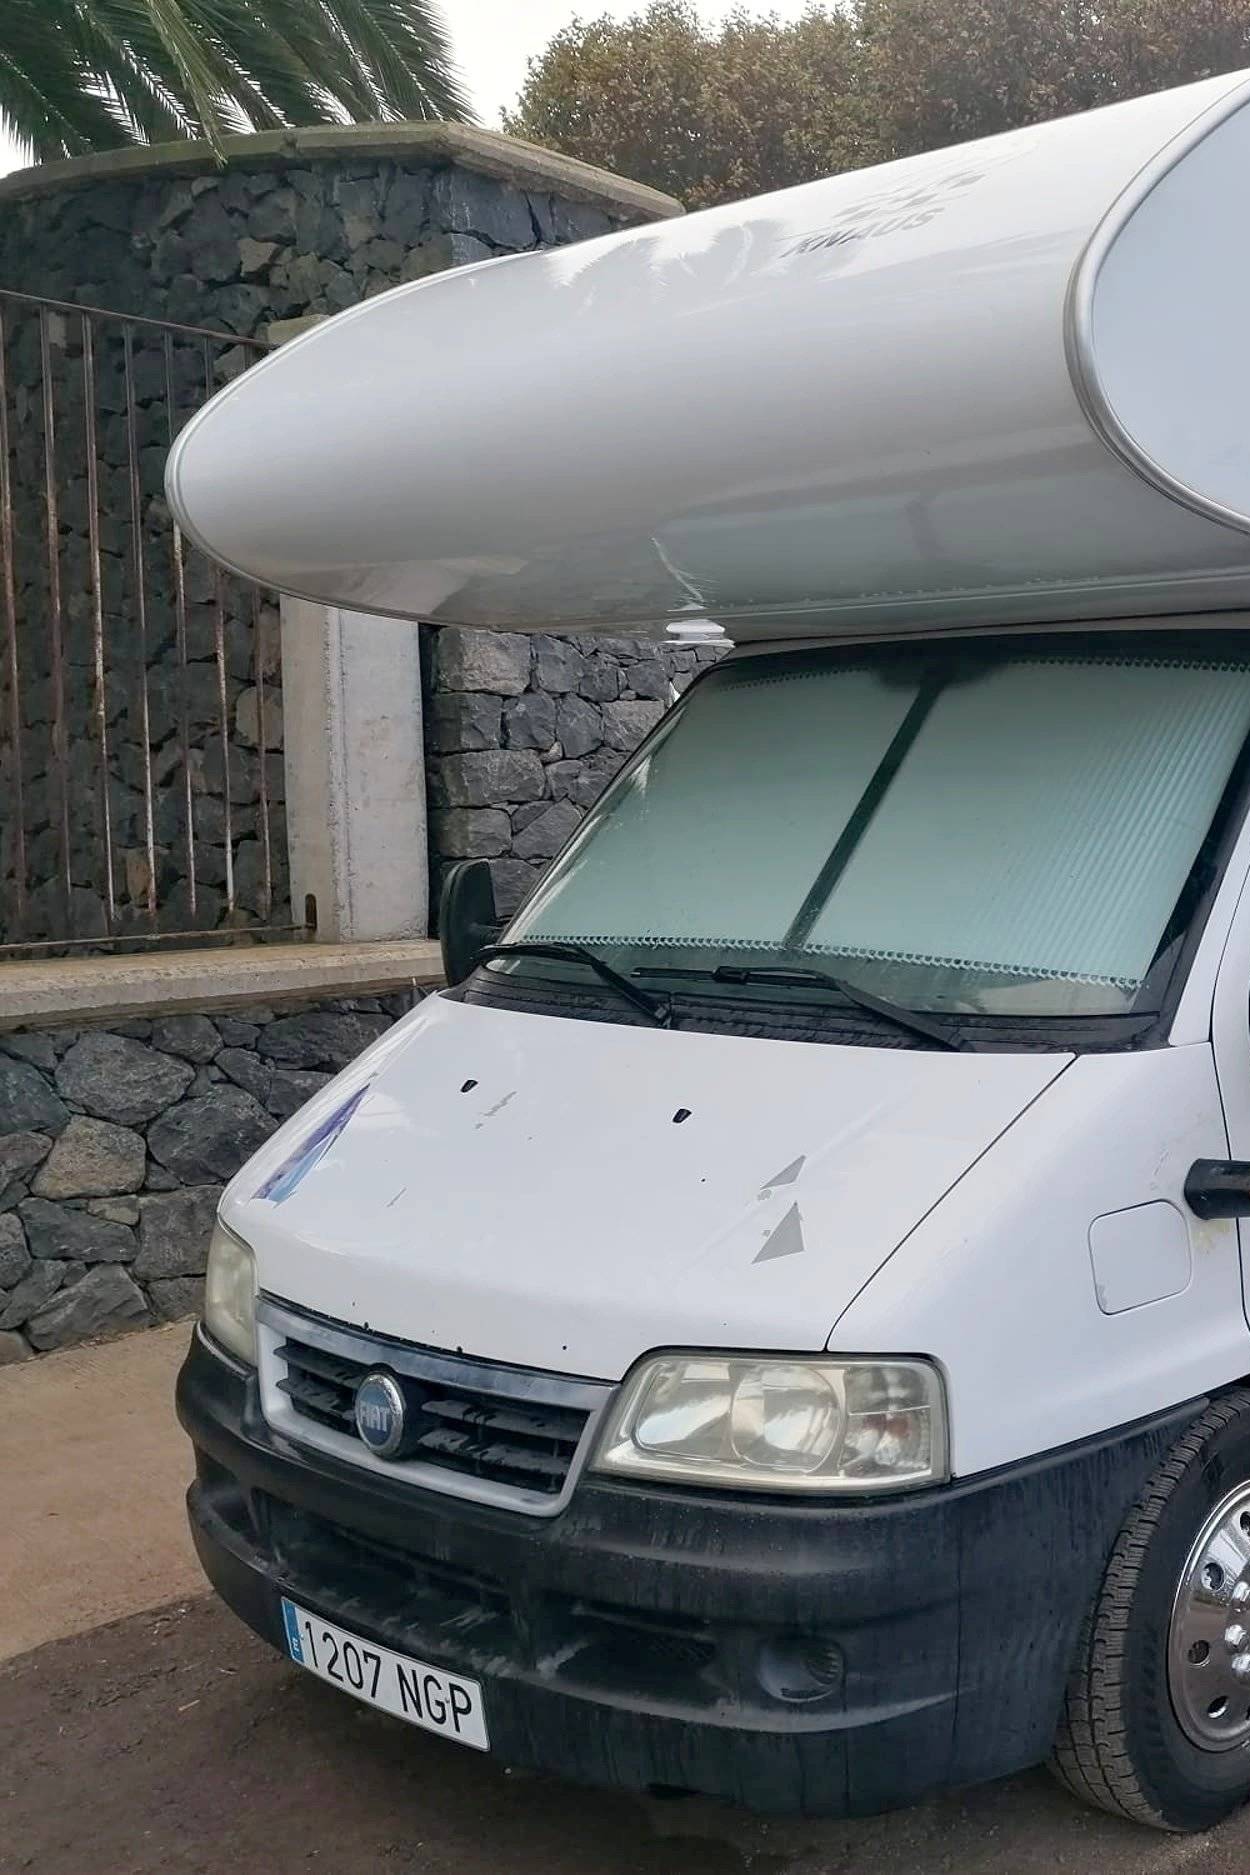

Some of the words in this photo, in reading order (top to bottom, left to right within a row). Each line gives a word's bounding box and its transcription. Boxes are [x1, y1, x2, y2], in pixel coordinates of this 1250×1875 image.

[779, 207, 945, 258] KNAUS
[360, 1401, 391, 1432] FIAT
[305, 1621, 381, 1698] 1207
[397, 1664, 472, 1733] NGP
